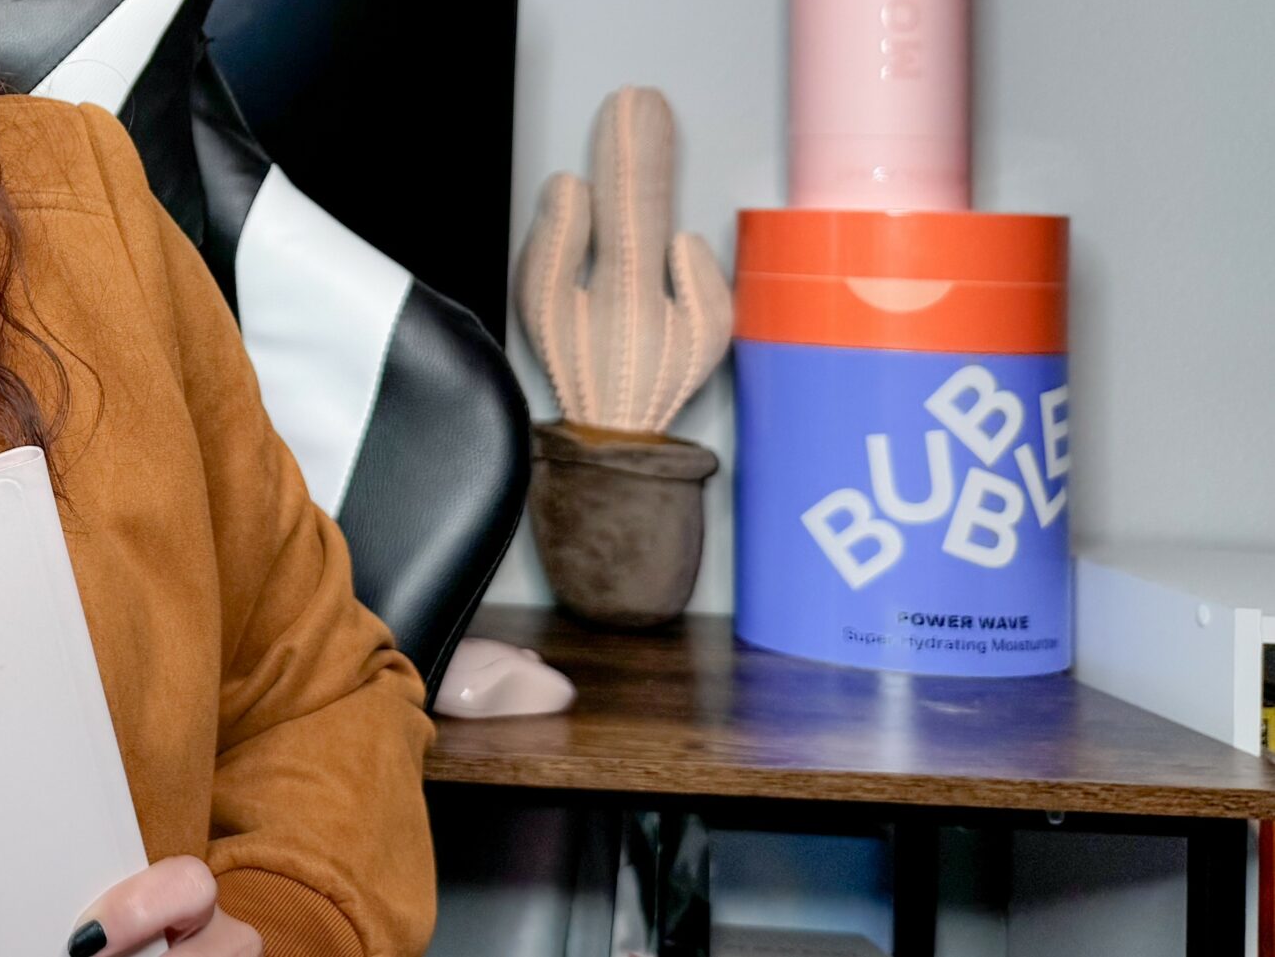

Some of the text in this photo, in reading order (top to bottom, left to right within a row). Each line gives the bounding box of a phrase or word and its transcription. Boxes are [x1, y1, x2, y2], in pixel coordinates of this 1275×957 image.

[897, 611, 1030, 631] POWER WAVE
[841, 625, 893, 646] Supe
